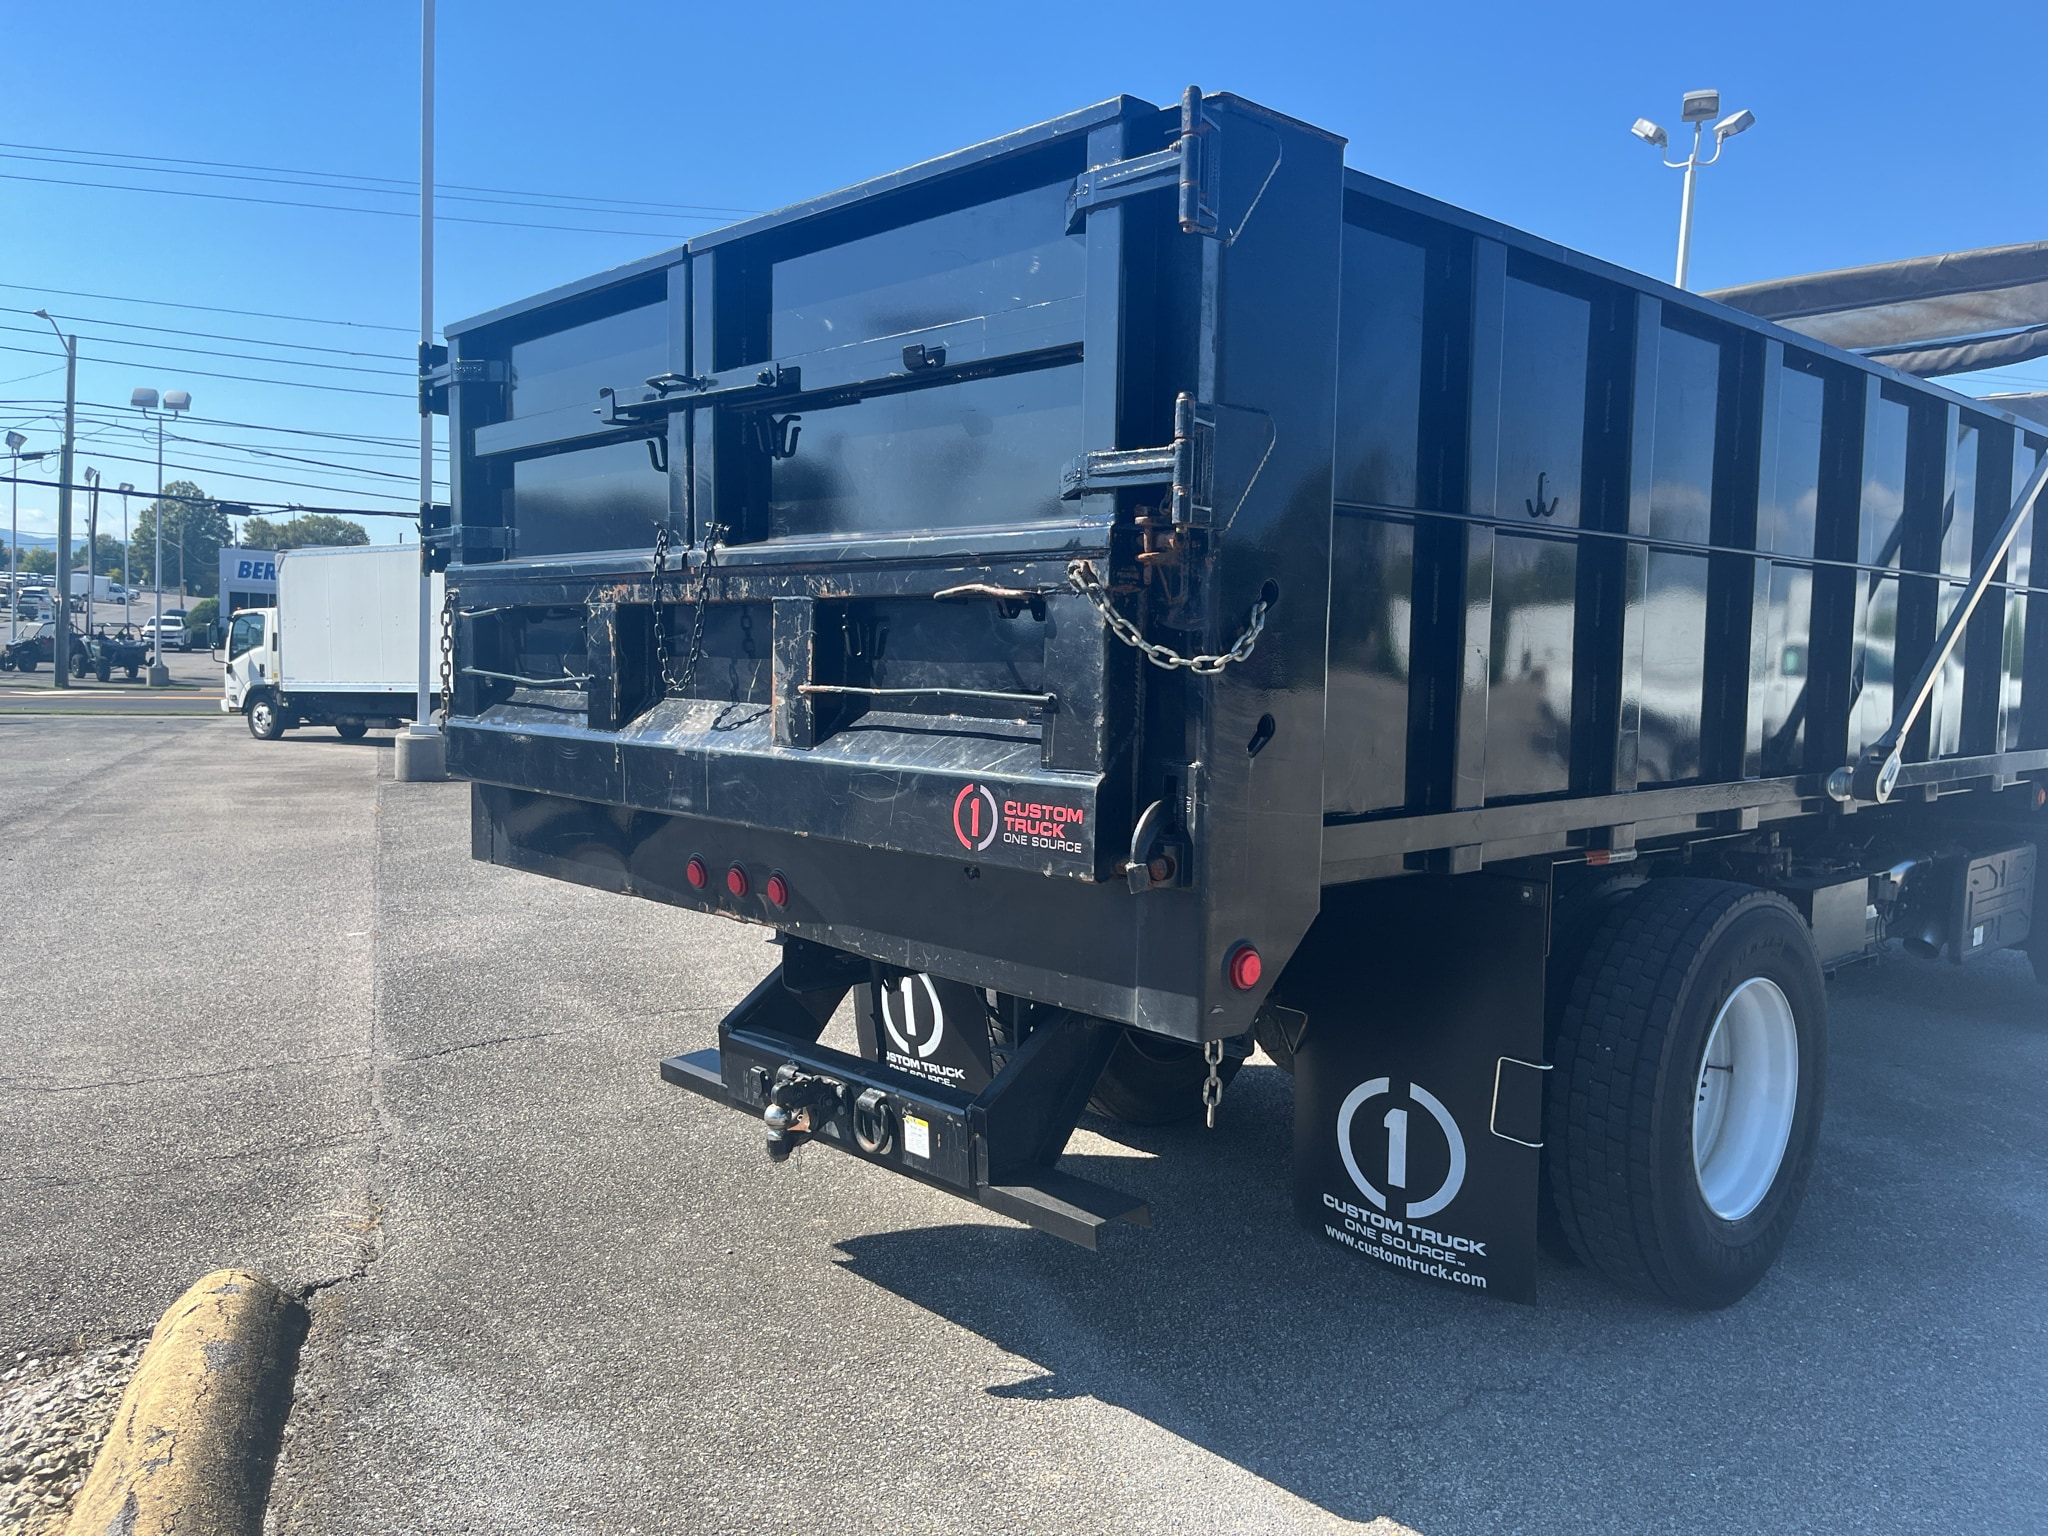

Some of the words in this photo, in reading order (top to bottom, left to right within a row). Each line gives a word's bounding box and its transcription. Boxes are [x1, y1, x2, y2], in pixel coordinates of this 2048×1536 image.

[1004, 800, 1083, 824] CUSTOM
[1003, 817, 1066, 839] TRUCK
[1003, 832, 1028, 846] ONE
[1031, 836, 1082, 854] SOURCE
[920, 1061, 966, 1080] TRUCK
[1322, 1193, 1403, 1235] CUSTOM
[1407, 1224, 1487, 1257] TRUCK
[1344, 1218, 1377, 1240] ONE
[1381, 1233, 1457, 1264] SOURCE
[1325, 1224, 1487, 1289] www.customtruck.com
